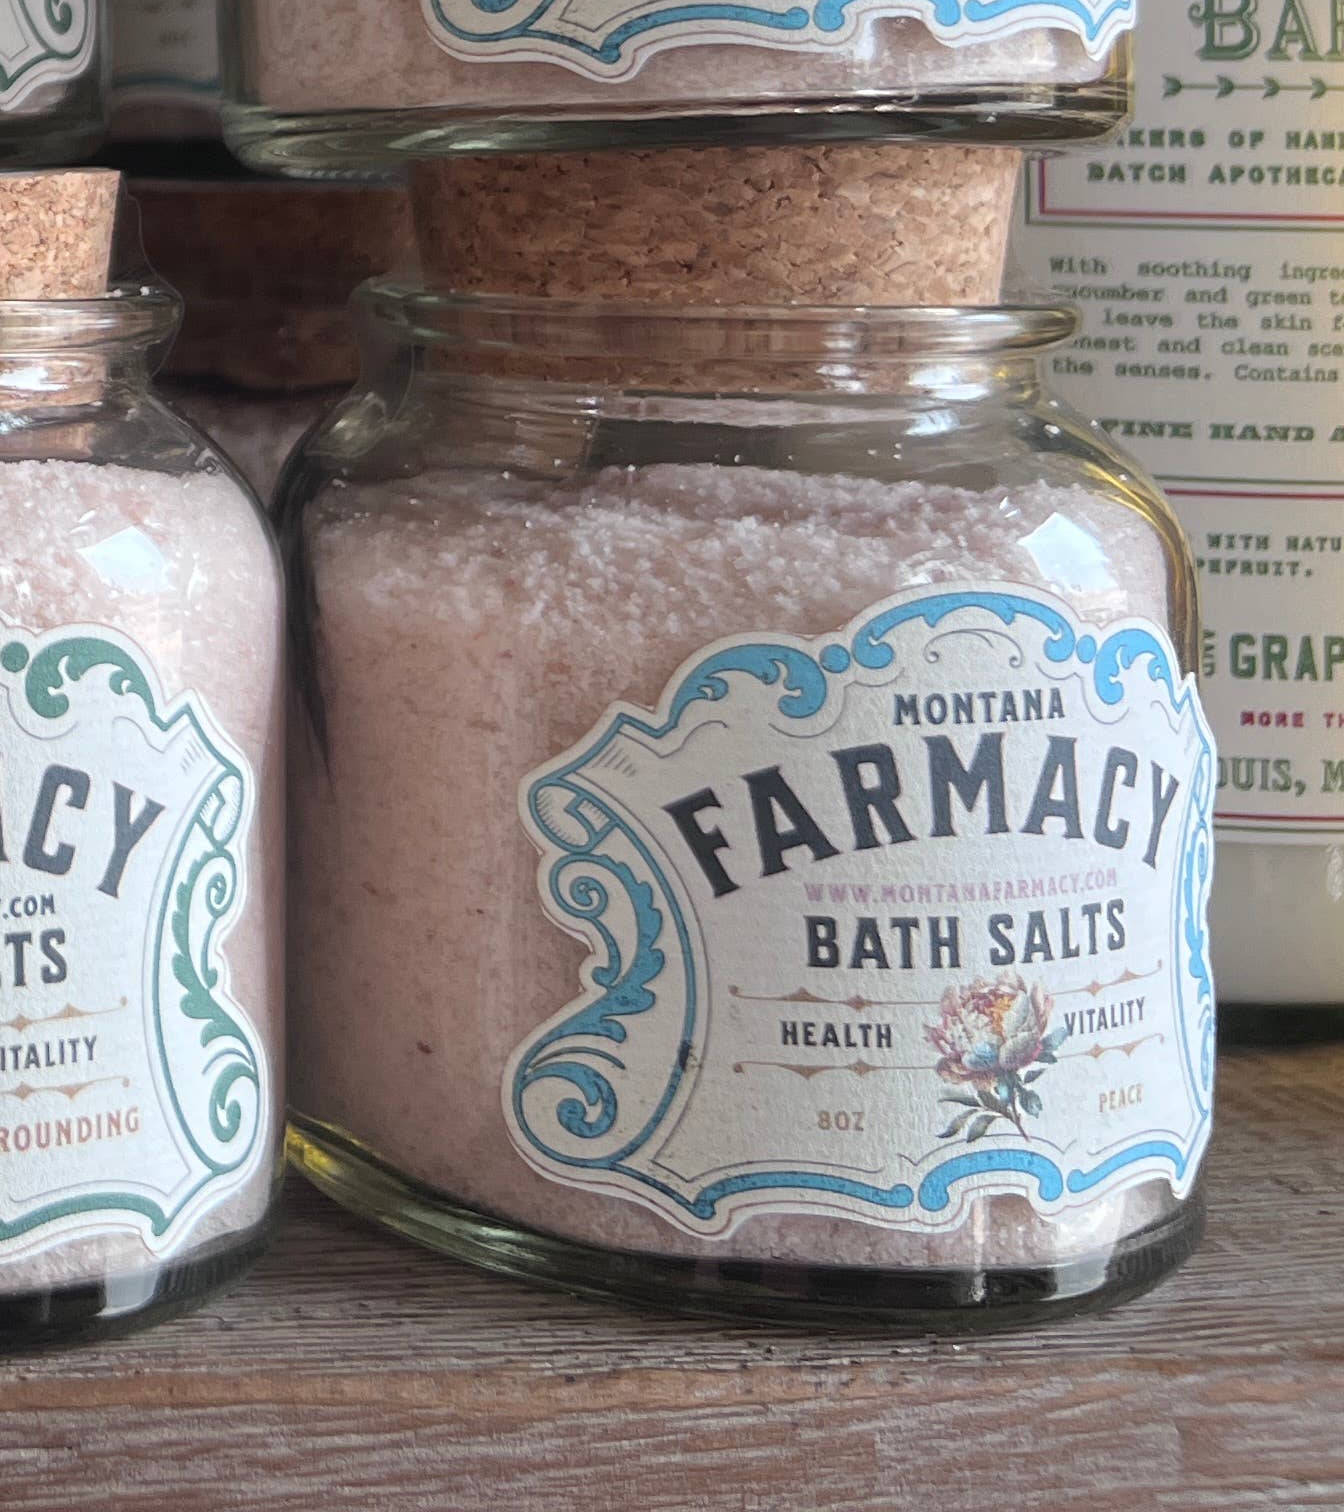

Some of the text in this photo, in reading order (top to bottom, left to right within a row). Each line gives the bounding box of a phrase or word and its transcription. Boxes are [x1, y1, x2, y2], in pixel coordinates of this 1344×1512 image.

[1228, 131, 1264, 148] OF
[1087, 163, 1185, 182] BATCH
[1050, 257, 1107, 274] With
[1137, 262, 1252, 281] soothing
[1184, 288, 1228, 304] and
[1246, 292, 1312, 308] green
[1103, 309, 1173, 328] leave
[1198, 312, 1238, 329] the
[1261, 315, 1312, 331] skin
[1157, 338, 1201, 354] and
[1221, 339, 1289, 356] clean
[1052, 358, 1339, 382] the senses. Contains
[1209, 423, 1314, 441] HAND
[1207, 533, 1270, 550] WITH
[892, 688, 1065, 726] MONTANA
[1240, 711, 1304, 728] MORE
[662, 733, 1179, 898] FARMACY
[805, 899, 1126, 969] BATH SALTS
[781, 996, 1146, 1049] HEALTH VITALITY
[1099, 1084, 1142, 1112] PEACE
